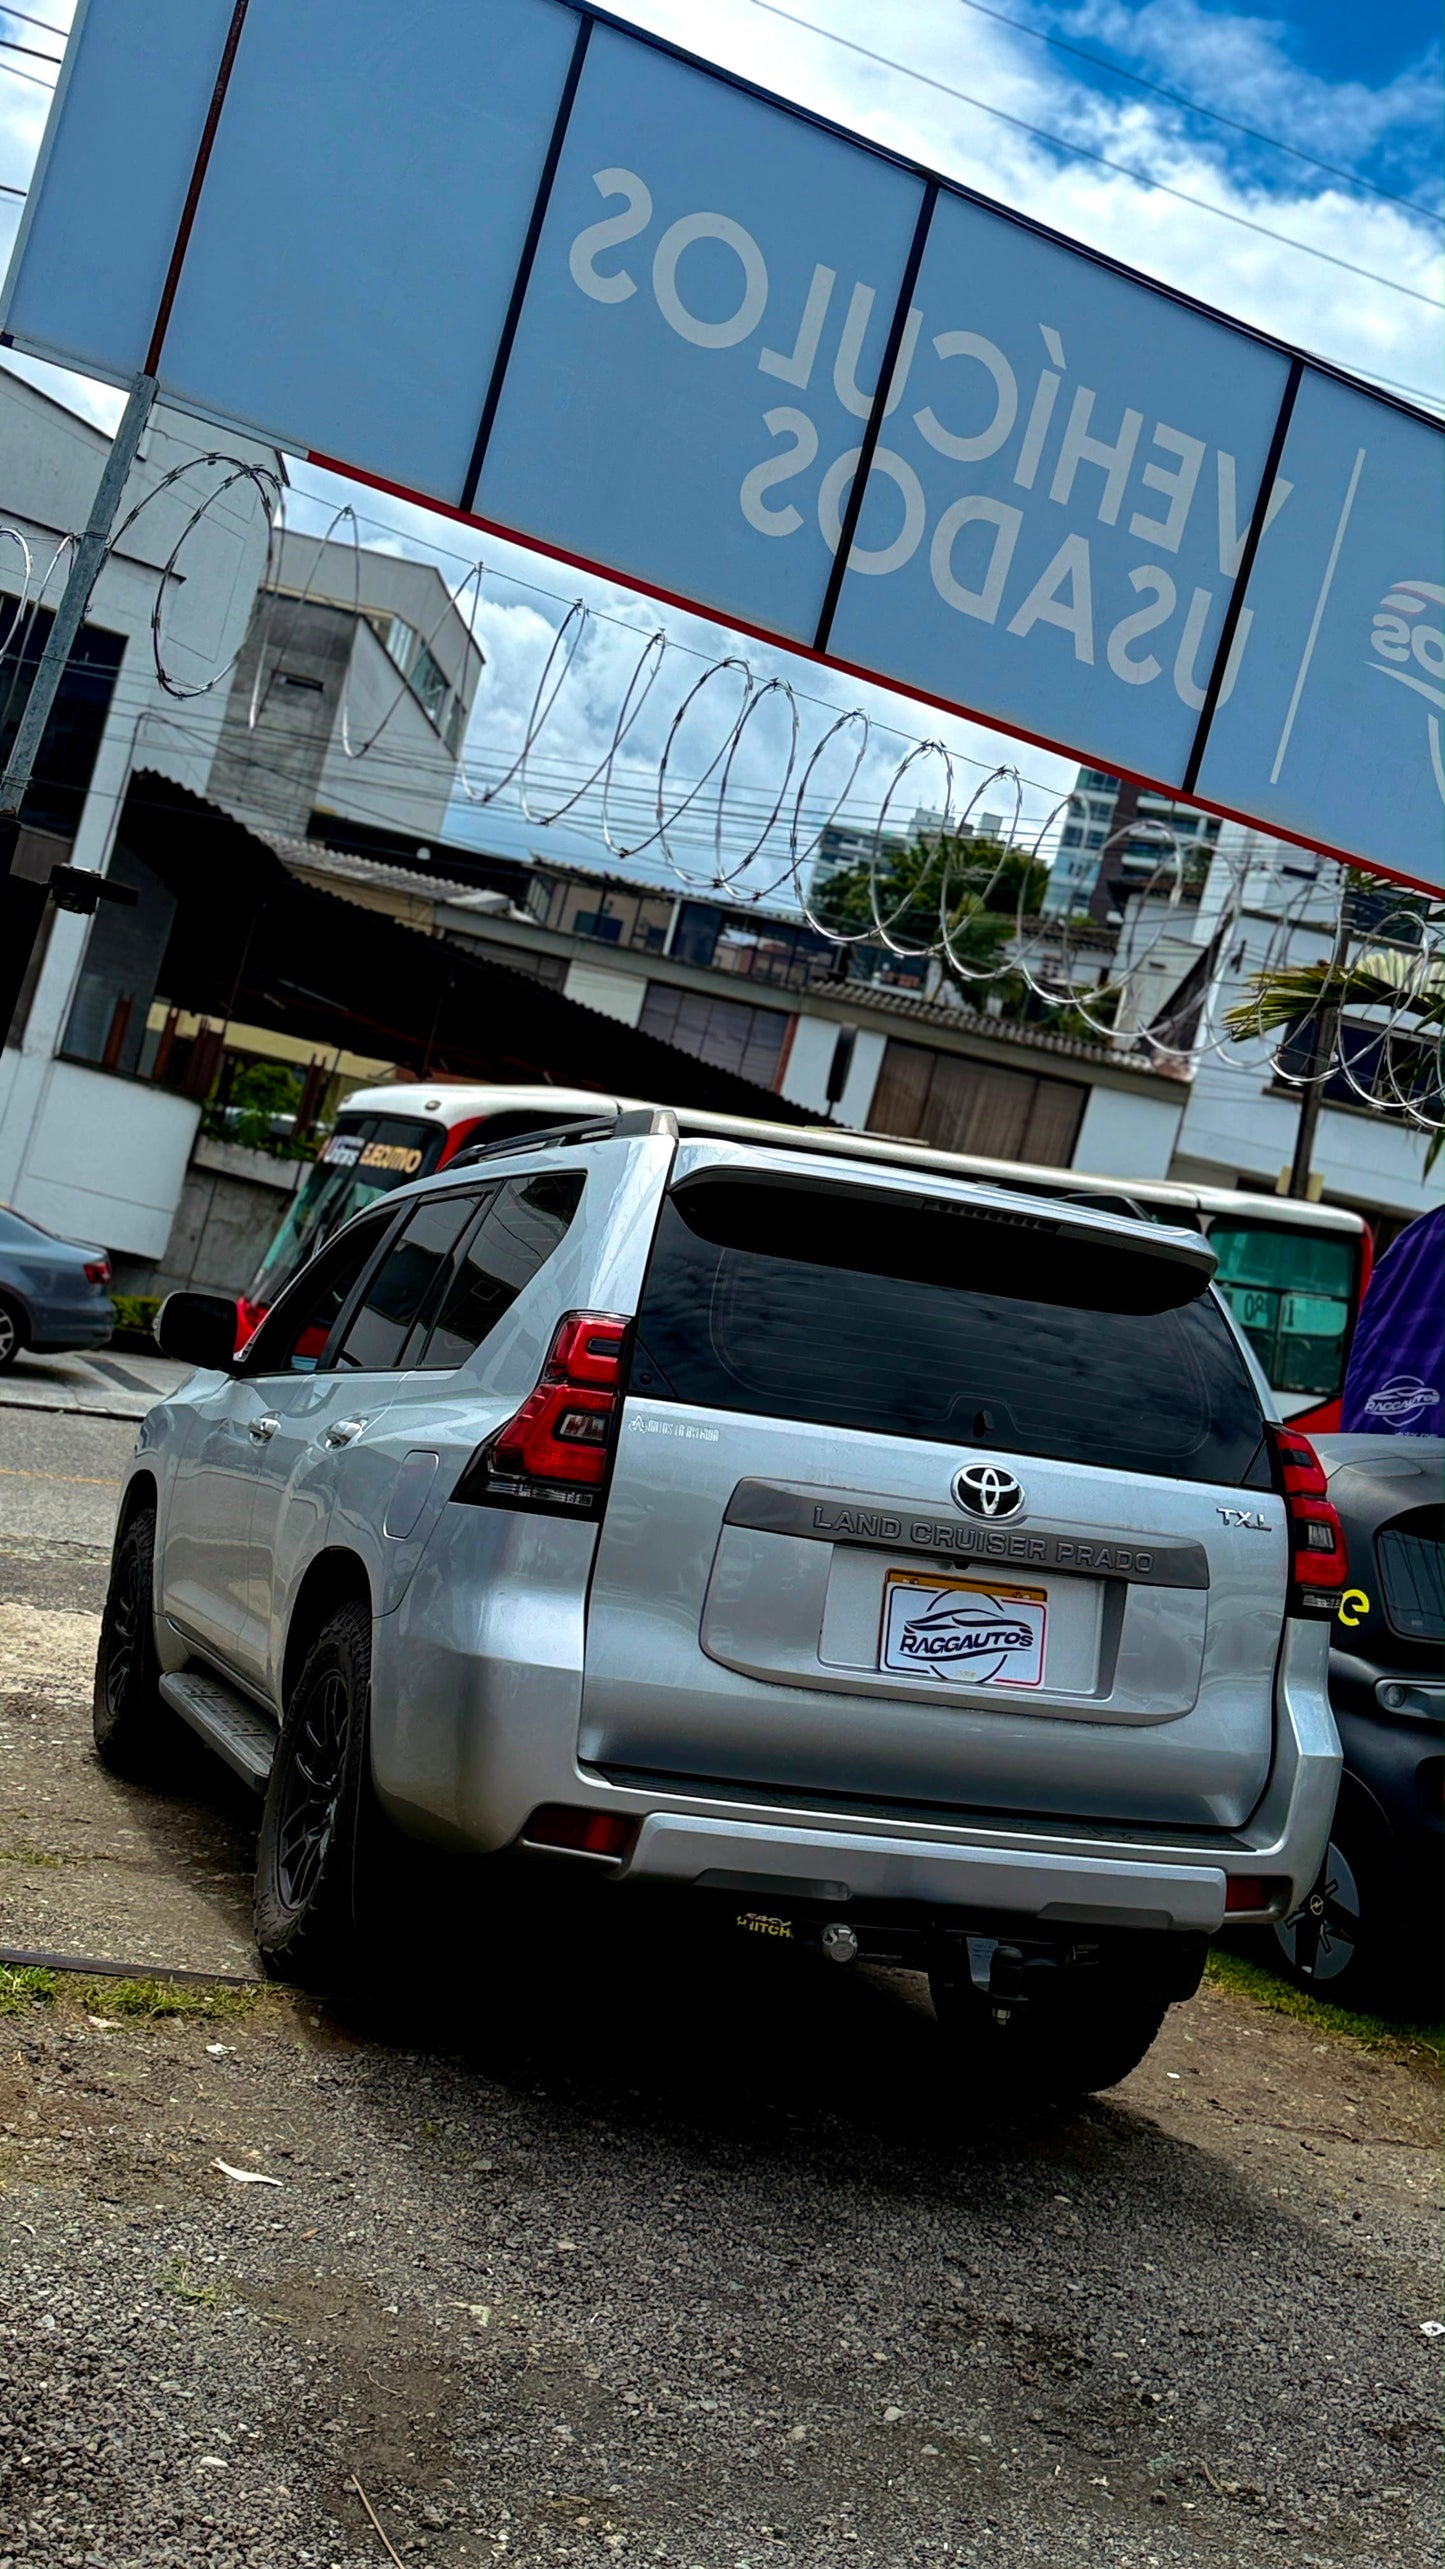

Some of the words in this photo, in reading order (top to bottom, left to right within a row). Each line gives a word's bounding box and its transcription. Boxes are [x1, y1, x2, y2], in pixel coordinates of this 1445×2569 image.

[813, 1506, 901, 1539] LAND
[910, 1522, 1047, 1561] CRUISER
[1056, 1541, 1154, 1574] PRADO
[900, 1632, 1034, 1654] RAGGAUTOS
